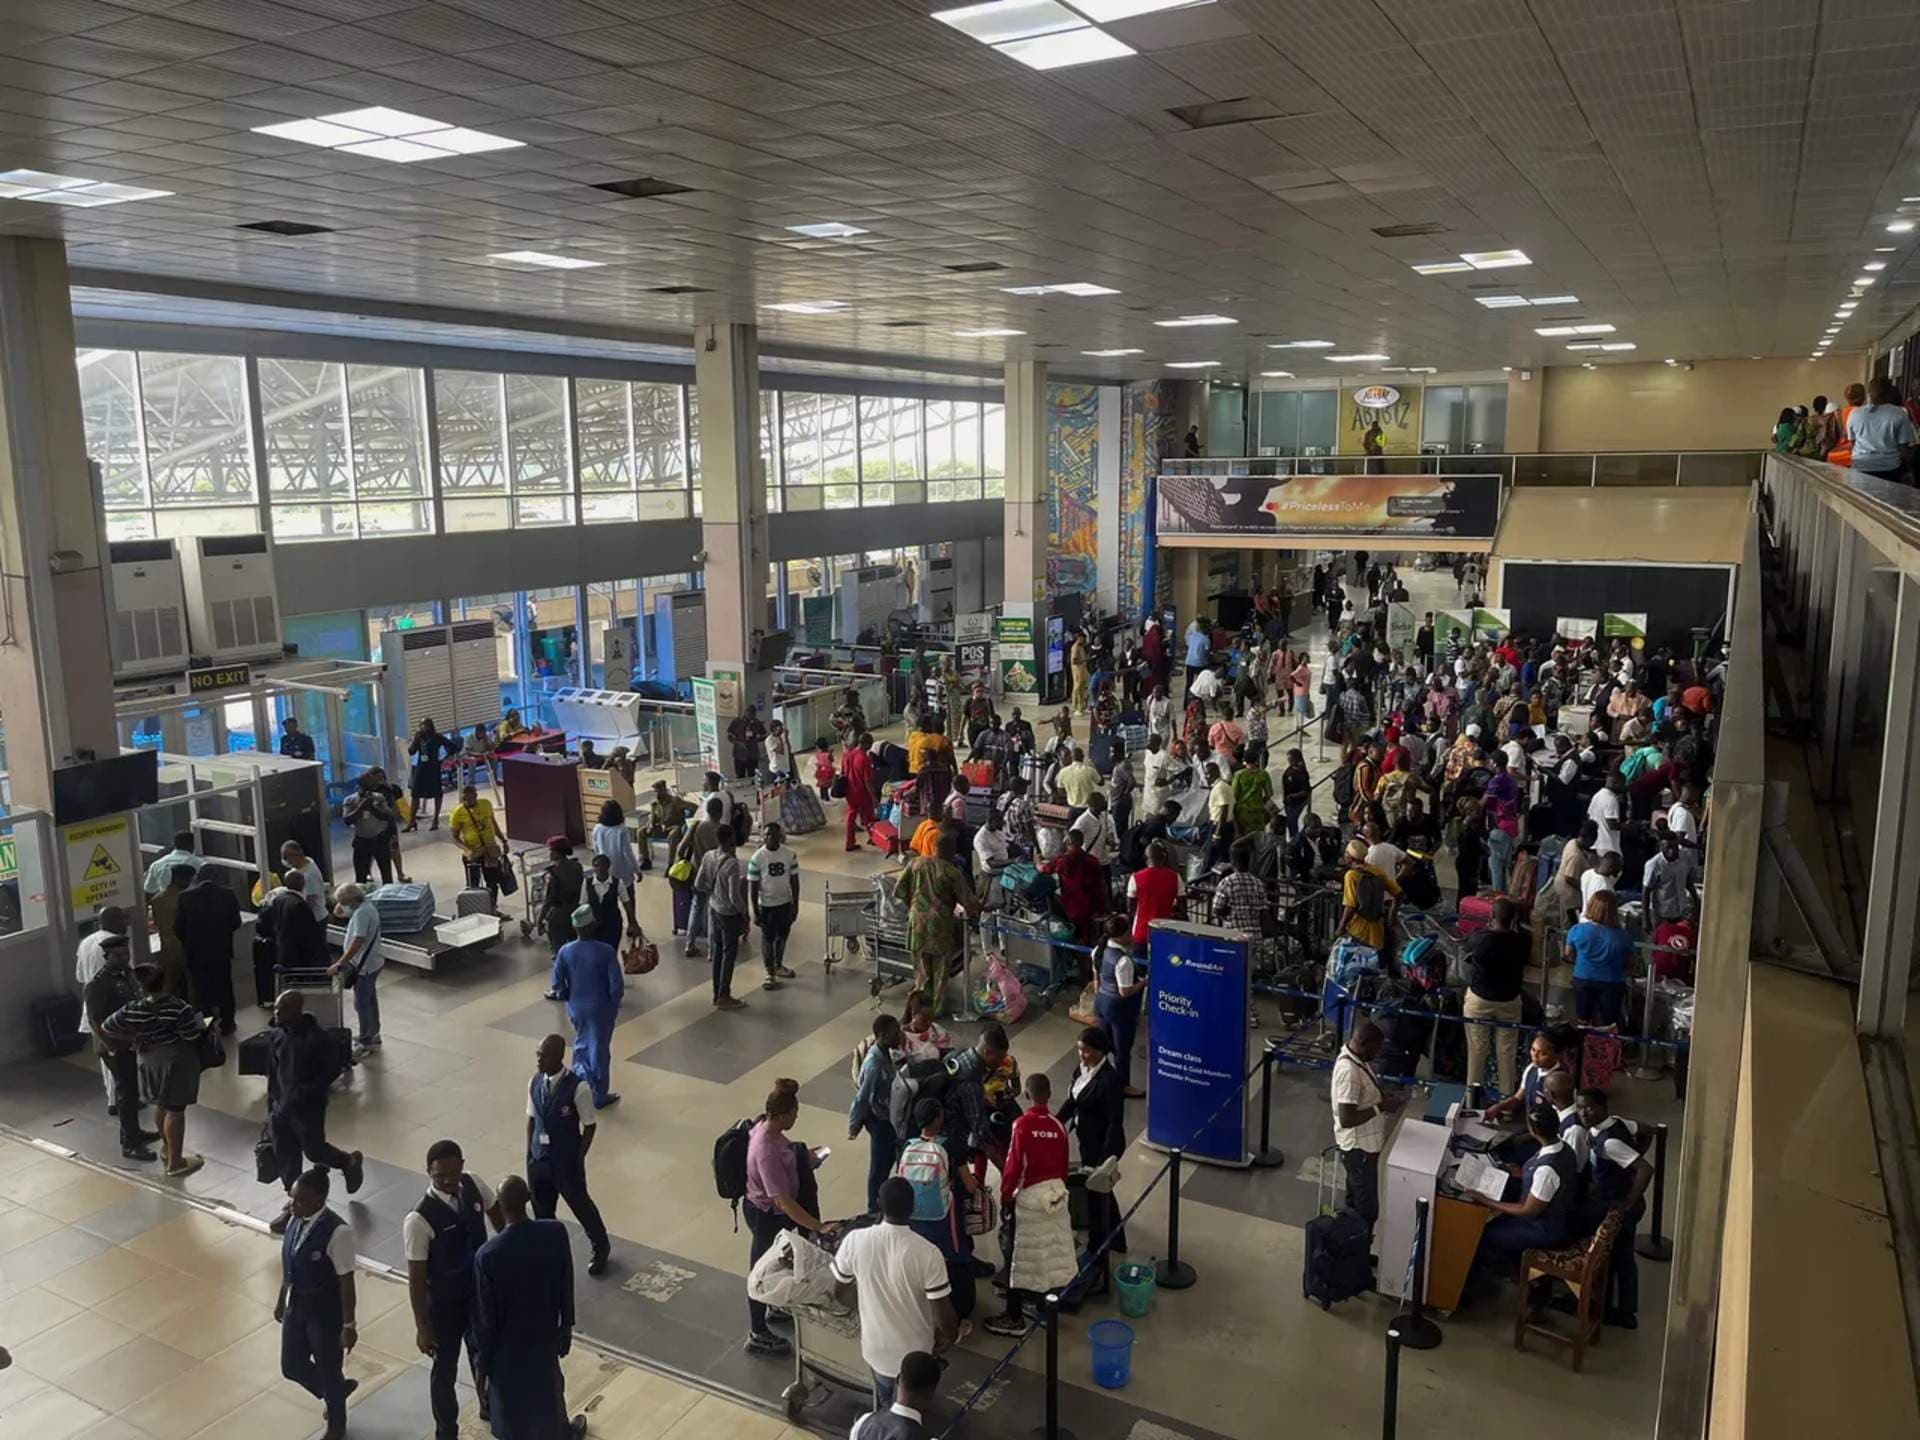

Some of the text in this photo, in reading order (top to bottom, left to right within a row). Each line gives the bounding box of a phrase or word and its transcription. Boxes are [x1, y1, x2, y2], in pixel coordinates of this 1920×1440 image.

[1281, 501, 1371, 512] #PricelessToMe
[961, 645, 985, 660] POS
[191, 671, 245, 688] NO EXIT
[1185, 959, 1224, 971] RwandAir
[1159, 990, 1192, 1007] Priority
[1158, 1001, 1199, 1018] Check-in
[1158, 1046, 1202, 1063] Dream class
